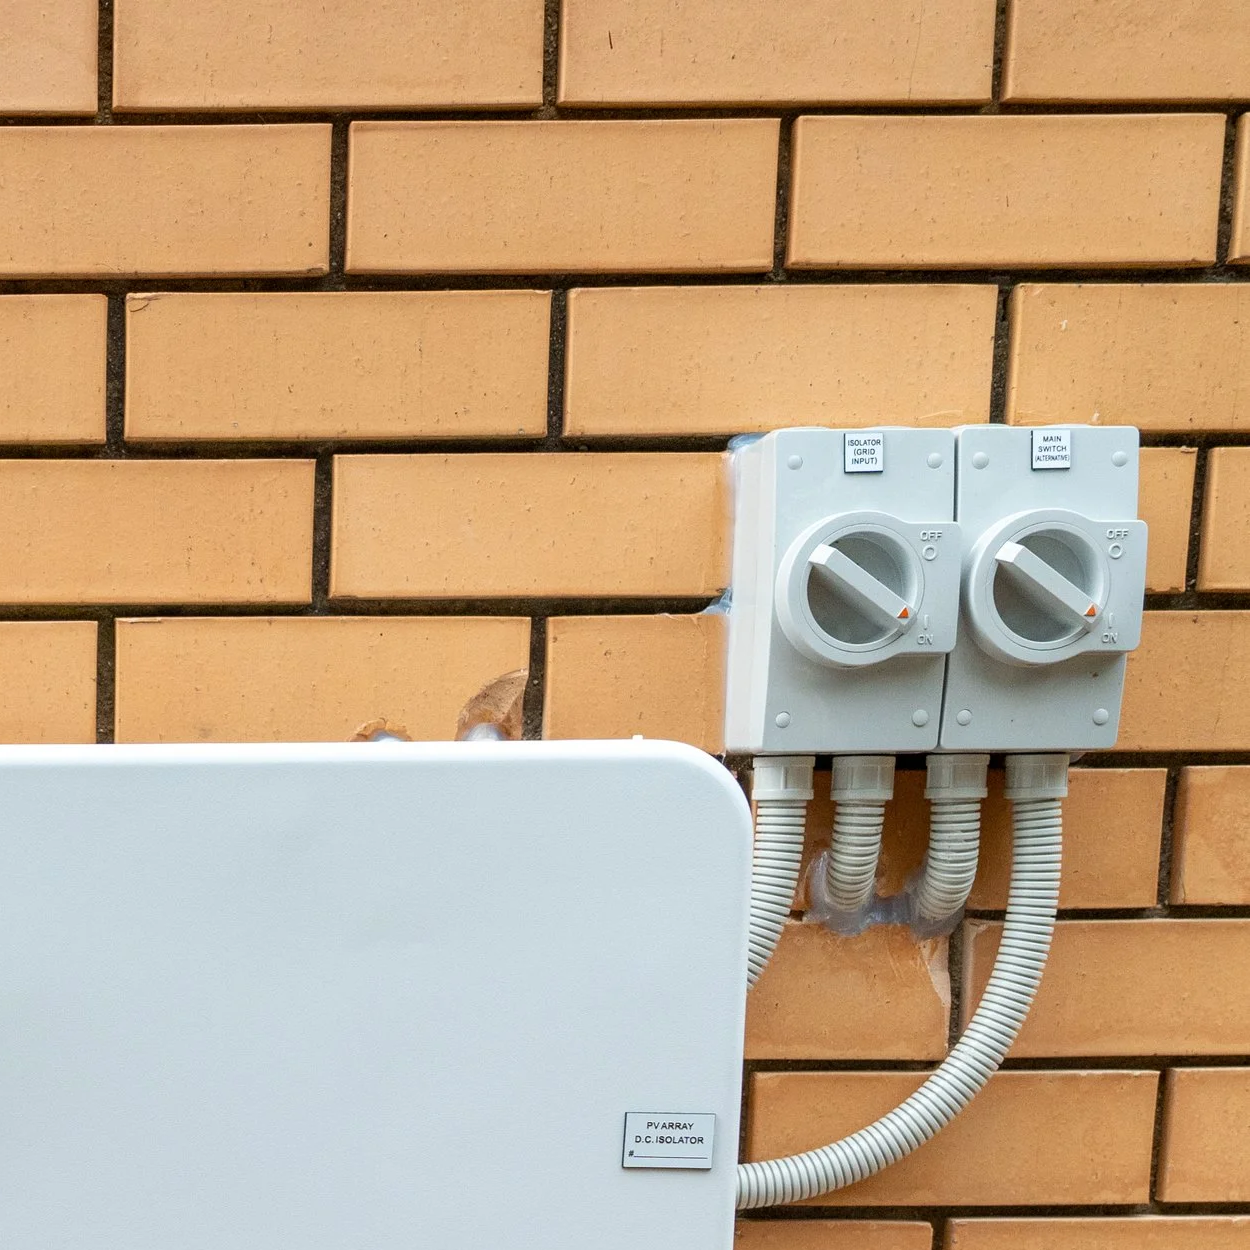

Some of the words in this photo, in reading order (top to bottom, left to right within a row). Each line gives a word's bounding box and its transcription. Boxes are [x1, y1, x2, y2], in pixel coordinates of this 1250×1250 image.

[854, 448, 875, 456] (GRID
[1039, 445, 1066, 453] SWITCH
[852, 457, 877, 465] INPUT)
[921, 532, 942, 541] OFF
[1107, 530, 1128, 539] OFF
[918, 635, 933, 645] ON
[1102, 633, 1117, 643] ON
[661, 1122, 694, 1130] ARRAY
